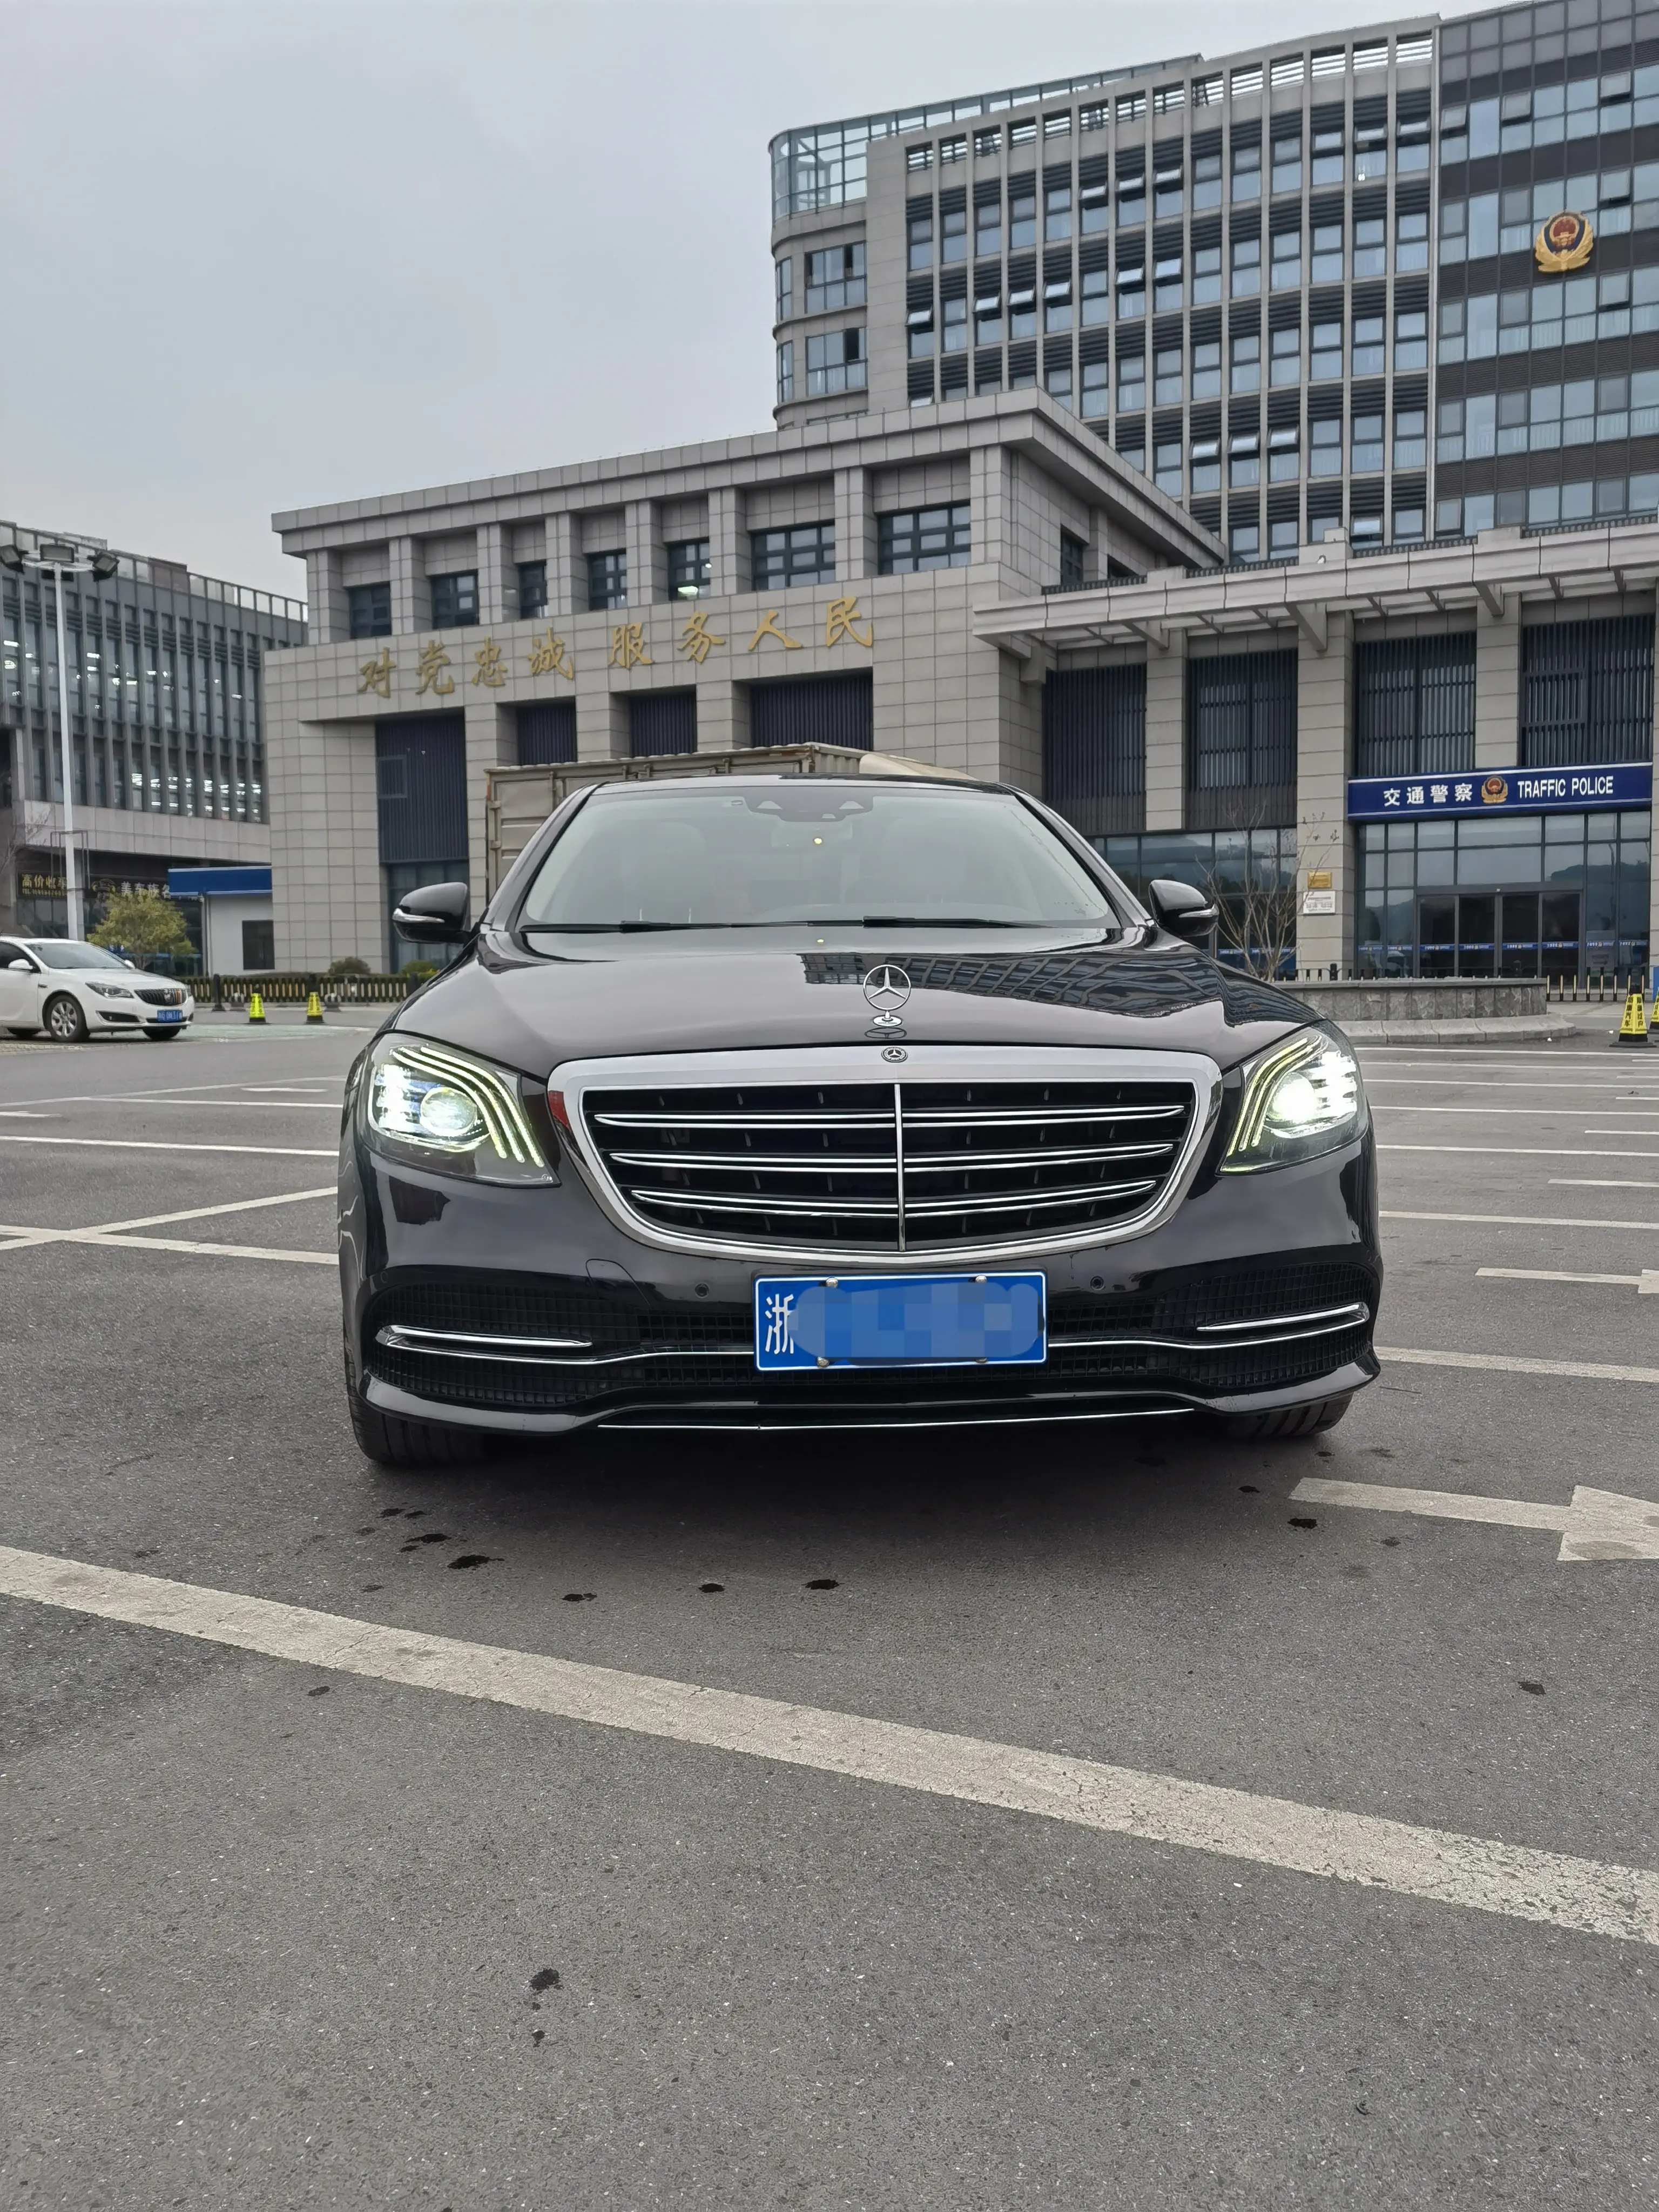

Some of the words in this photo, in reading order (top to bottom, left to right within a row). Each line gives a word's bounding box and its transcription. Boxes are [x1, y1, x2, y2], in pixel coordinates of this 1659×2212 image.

[358, 626, 575, 699] 对党忠诚
[608, 595, 874, 670] 服务人民
[1384, 782, 1473, 807] 交通警察
[1517, 778, 1566, 799] TRAFFIC
[1571, 775, 1614, 796] POLICE
